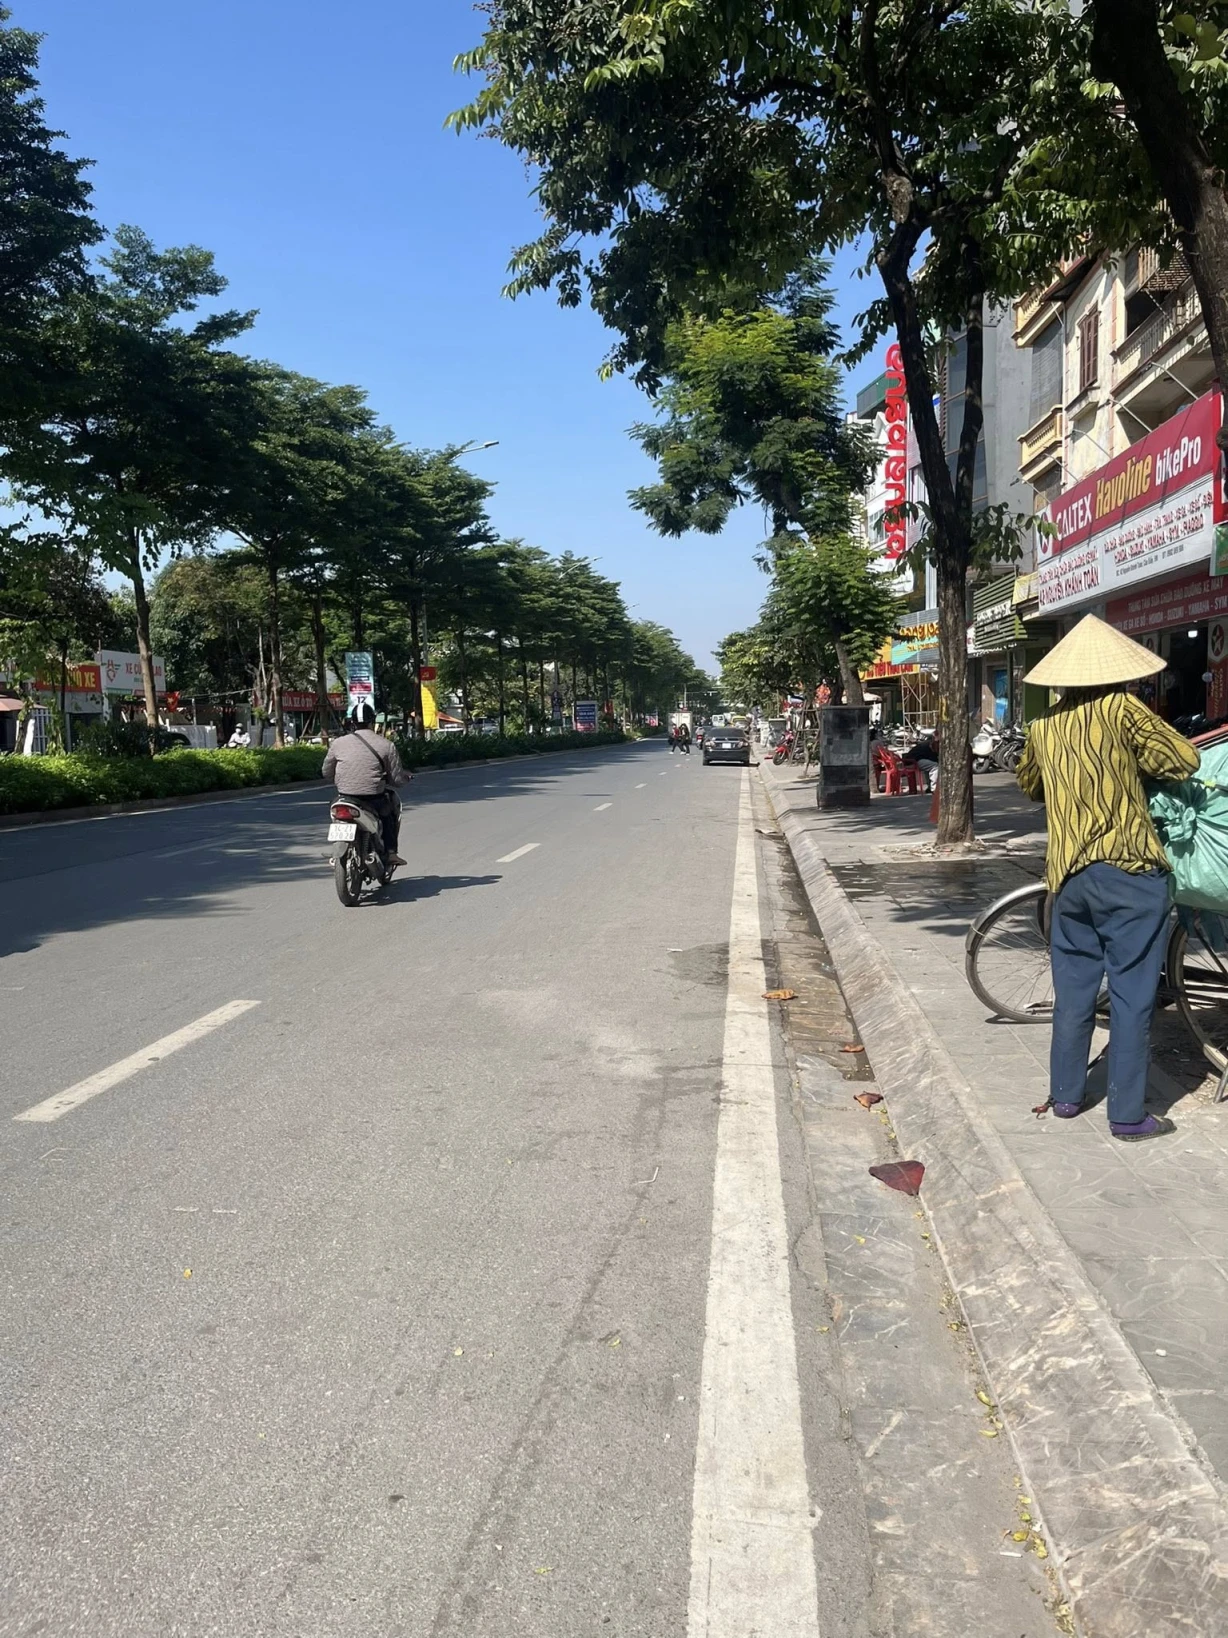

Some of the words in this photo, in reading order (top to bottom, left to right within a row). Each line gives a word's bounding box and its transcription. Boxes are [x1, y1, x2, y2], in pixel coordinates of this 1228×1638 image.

[1056, 492, 1093, 541] CALTEX
[1095, 454, 1152, 520] Havoline
[1155, 435, 1202, 486] bikePro
[84, 671, 96, 687] XE
